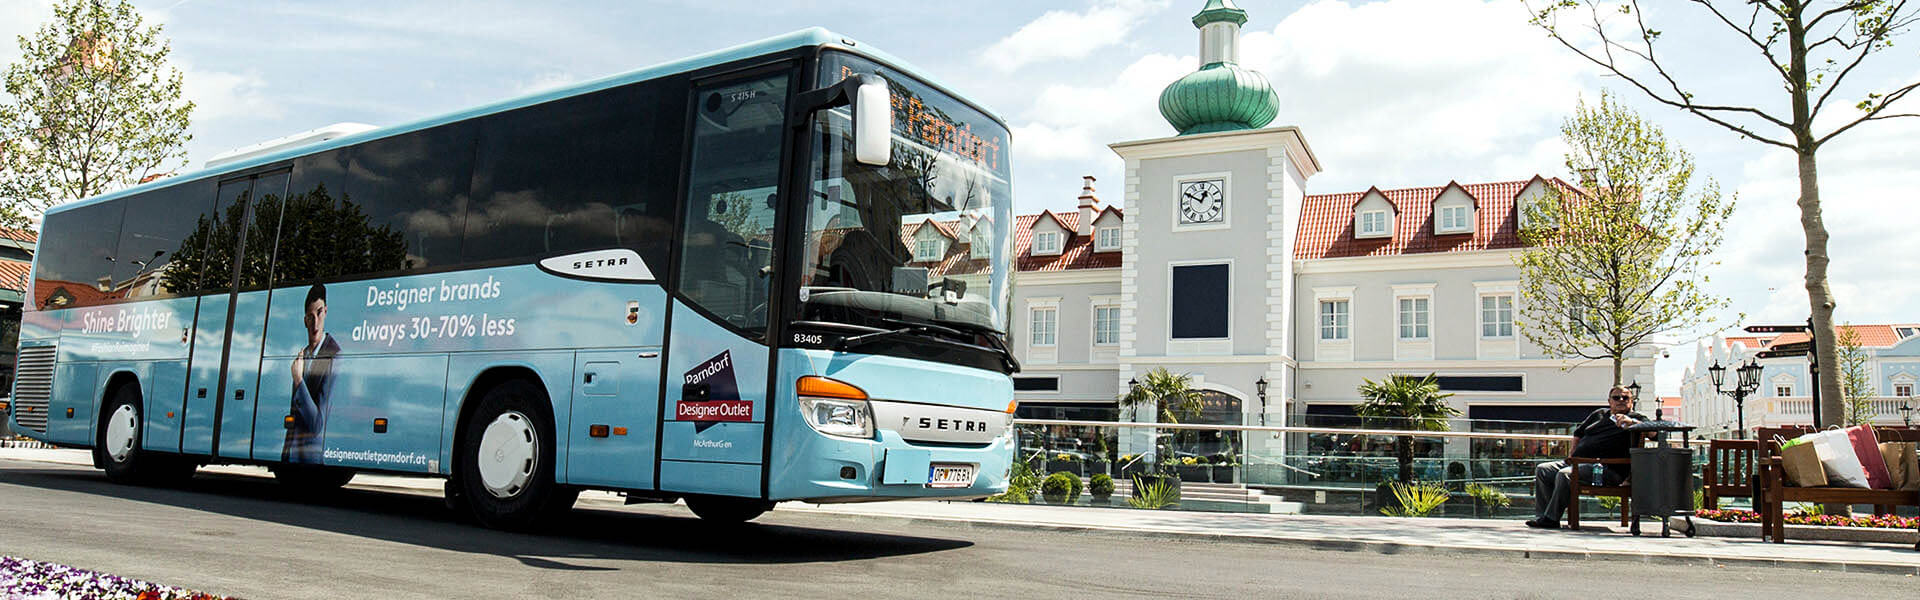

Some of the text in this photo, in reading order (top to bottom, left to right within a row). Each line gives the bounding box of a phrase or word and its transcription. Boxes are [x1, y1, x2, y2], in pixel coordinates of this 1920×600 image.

[573, 257, 628, 269] SETRA
[366, 275, 501, 311] Designer brands
[82, 307, 172, 338] Shine Brighter
[352, 313, 515, 346] always 30-70% less
[793, 333, 822, 344] 83405
[685, 353, 729, 384] Parndorf
[679, 403, 750, 418] Designer Outlet
[919, 417, 987, 432] SETRA
[693, 439, 732, 448] McArthurGen
[323, 448, 426, 464] designeroutletparndorf.at
